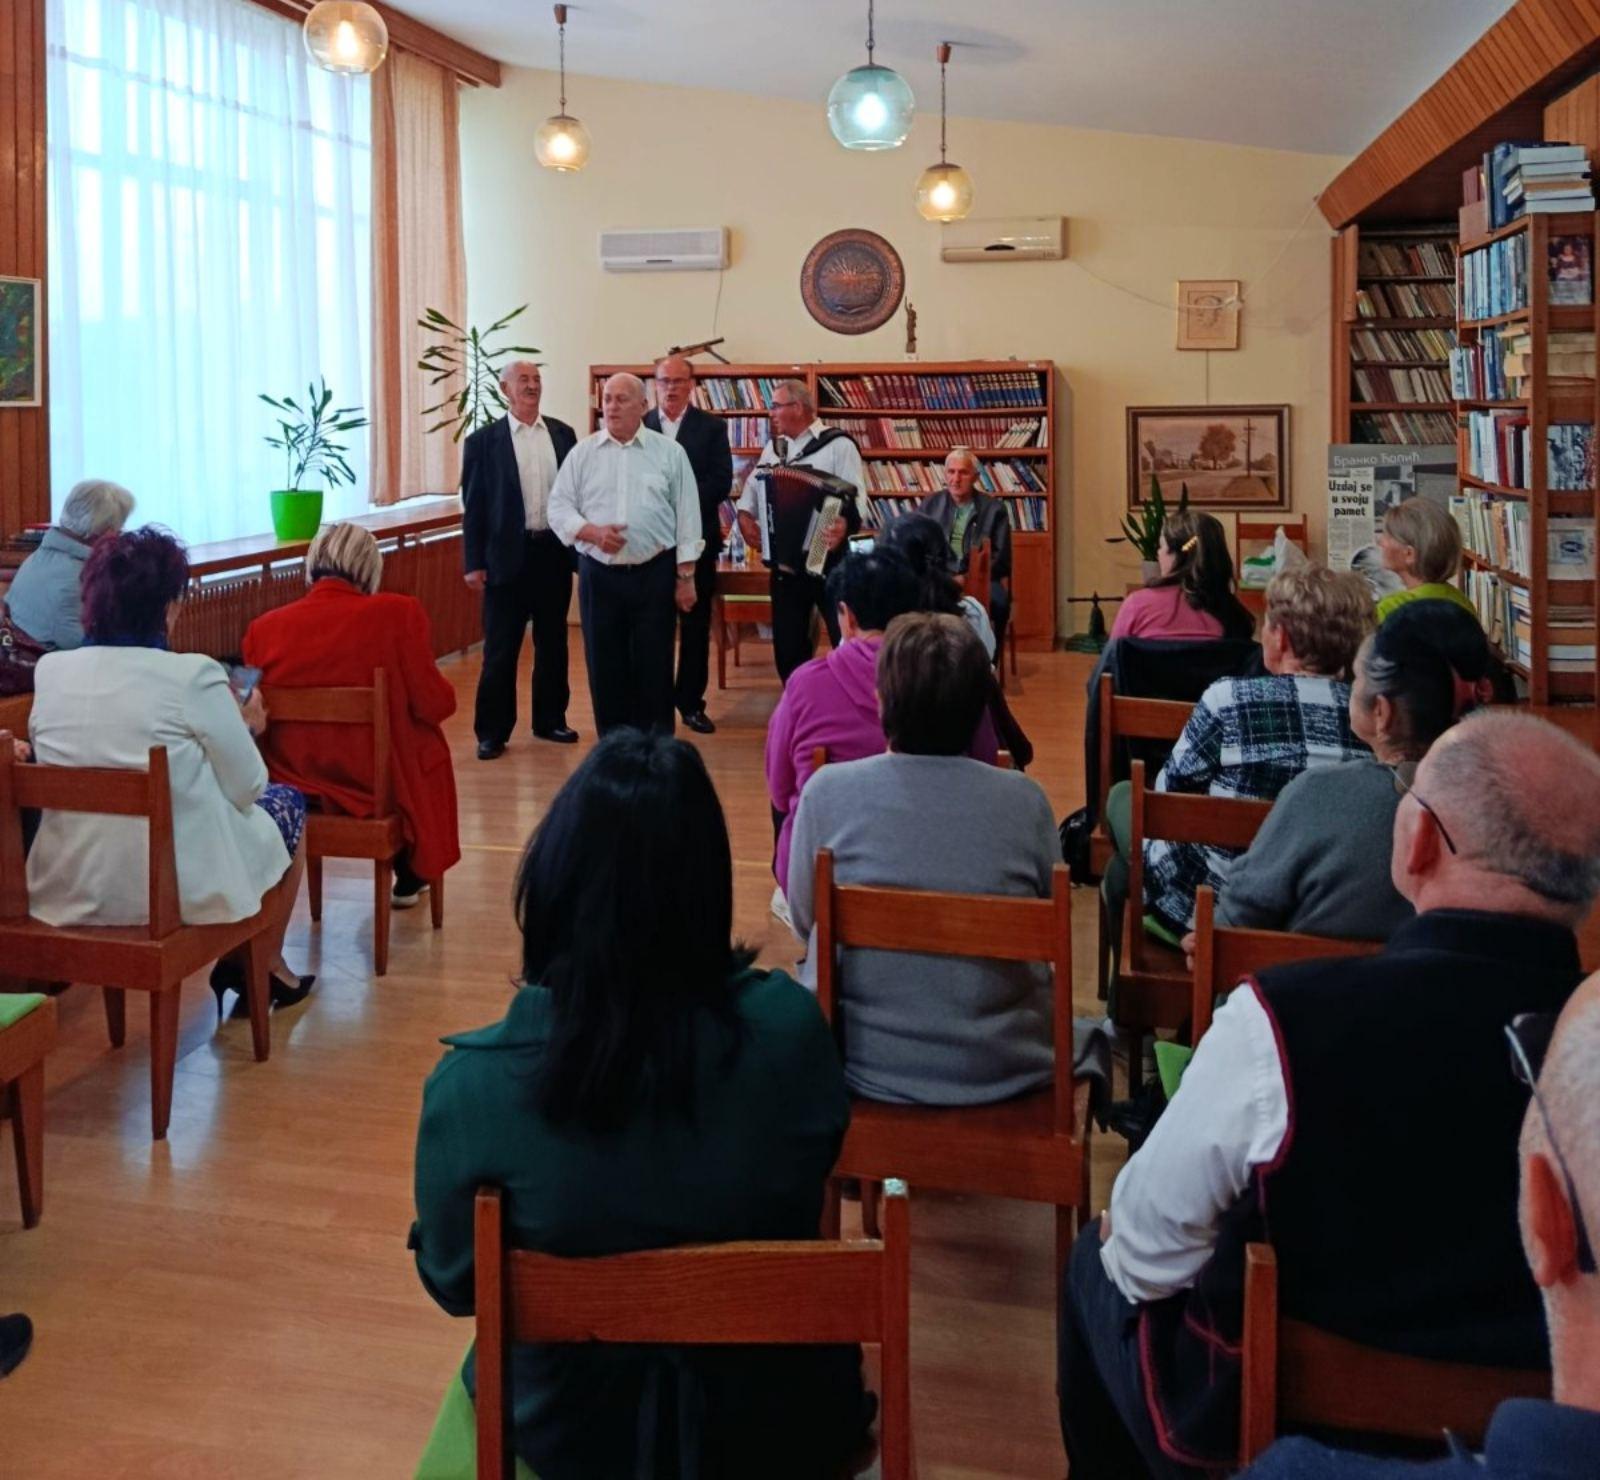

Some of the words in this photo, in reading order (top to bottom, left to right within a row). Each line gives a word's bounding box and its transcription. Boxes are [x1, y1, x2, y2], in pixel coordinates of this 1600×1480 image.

[1334, 455, 1377, 468] Бранко
[1328, 480, 1357, 493] Uzdaj
[1360, 483, 1373, 492] se
[1332, 495, 1338, 504] u
[1341, 494, 1369, 505] svoju
[1334, 507, 1366, 518] pamet
